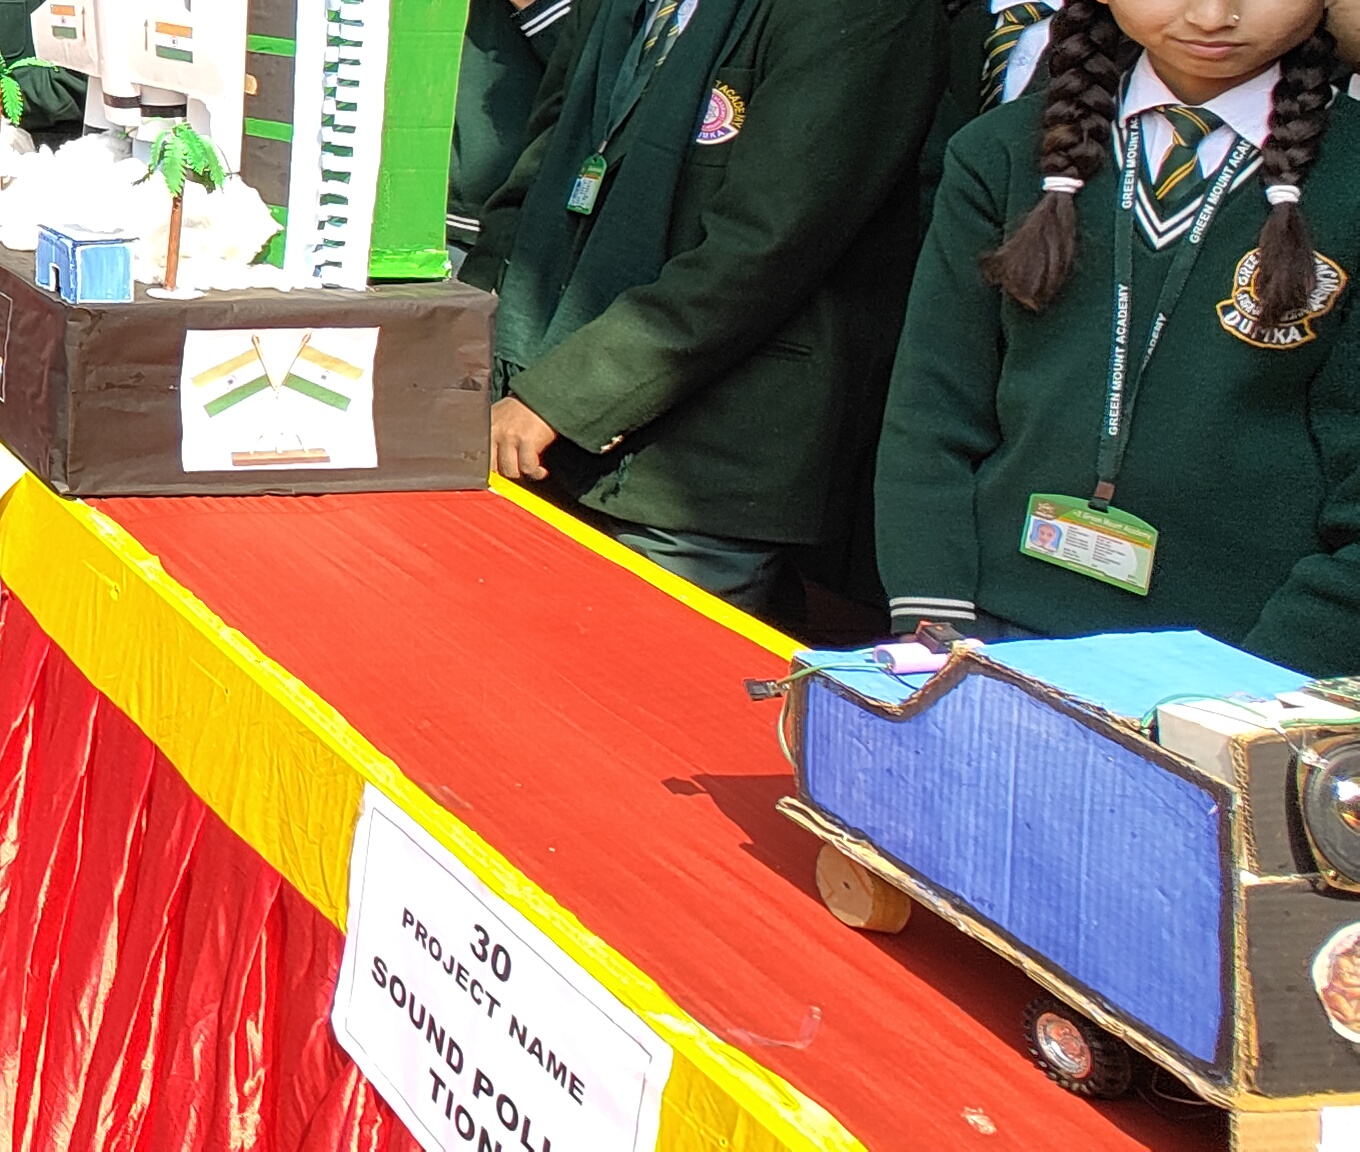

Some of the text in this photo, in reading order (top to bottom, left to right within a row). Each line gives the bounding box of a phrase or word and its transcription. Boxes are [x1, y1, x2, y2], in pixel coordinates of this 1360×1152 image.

[1122, 168, 1136, 210] GREEN
[1126, 131, 1140, 169] MOUNT
[1189, 204, 1211, 244] GREEN
[1208, 166, 1234, 205] MOUNT
[1108, 283, 1130, 436] GREEN MOUNT ACADEMY
[469, 923, 512, 983] 30
[370, 956, 465, 1076] SOUND
[401, 906, 586, 1107] PROJECT NAME
